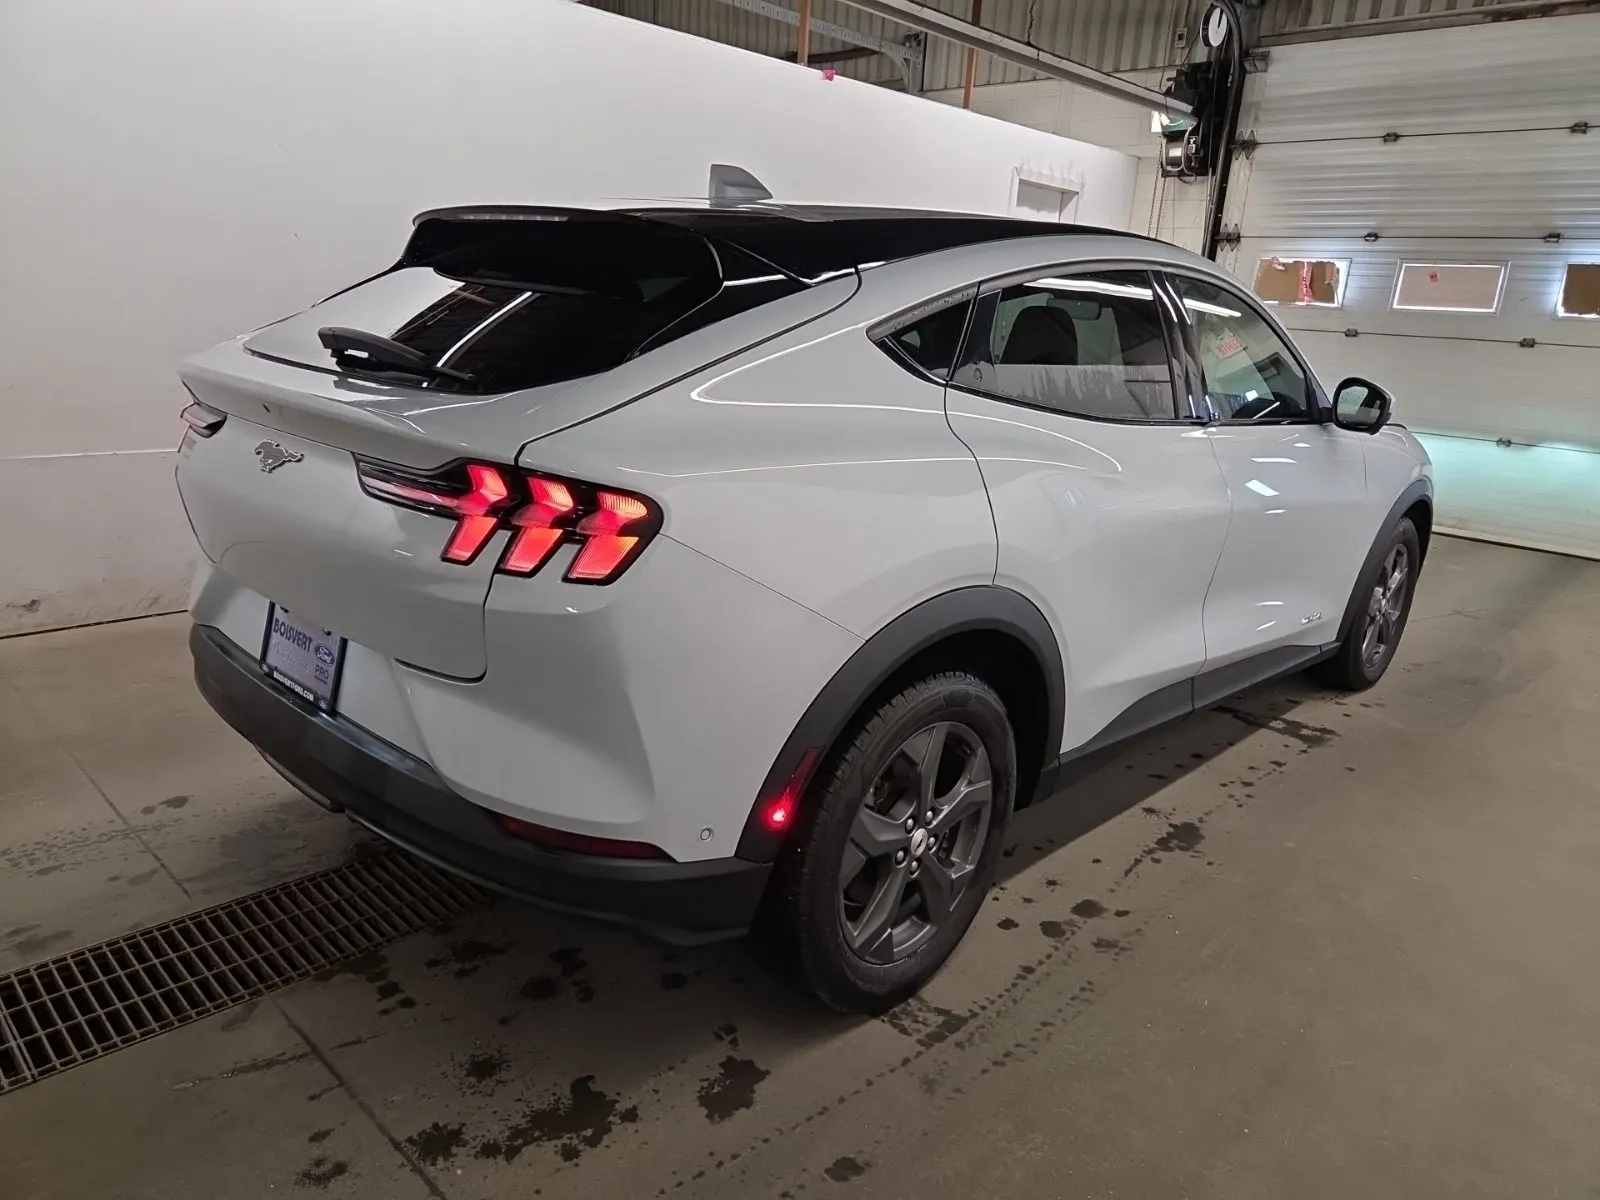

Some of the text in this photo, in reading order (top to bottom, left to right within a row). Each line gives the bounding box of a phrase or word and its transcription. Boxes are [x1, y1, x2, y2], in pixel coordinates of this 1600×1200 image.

[273, 617, 313, 652] BOISVERT
[317, 647, 333, 663] Ford
[315, 664, 330, 680] PRO
